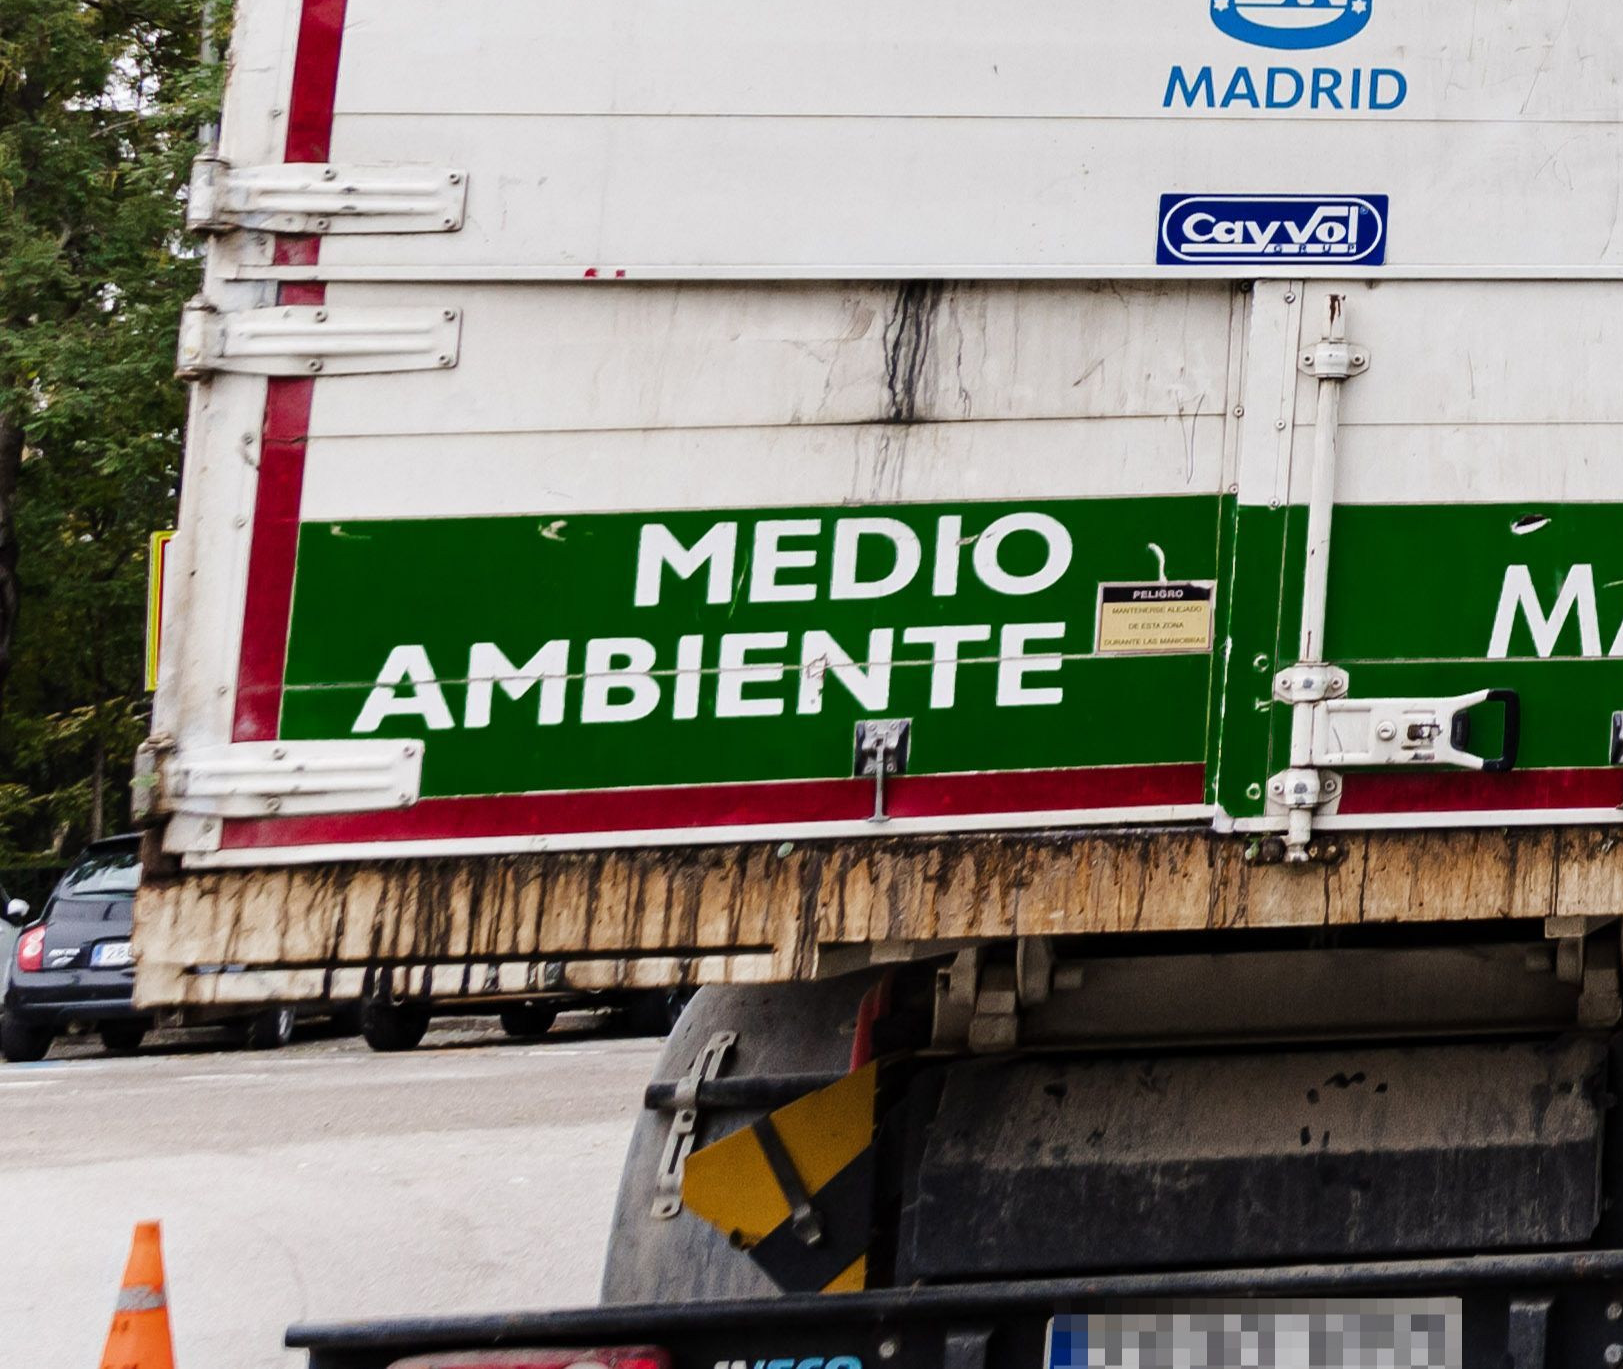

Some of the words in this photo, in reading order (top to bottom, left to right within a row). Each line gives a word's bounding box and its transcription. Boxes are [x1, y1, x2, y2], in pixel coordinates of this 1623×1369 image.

[1162, 66, 1408, 110] MADRID
[634, 511, 1073, 608] MEDIO
[1132, 589, 1184, 600] PELIGRO
[1167, 606, 1202, 614] ALEJADO
[1141, 622, 1160, 630] ESTA
[1162, 621, 1184, 629] ZONA
[1103, 638, 1141, 646] DURANTE
[1143, 637, 1157, 645] LAS
[351, 621, 1067, 734] AMBIENTE
